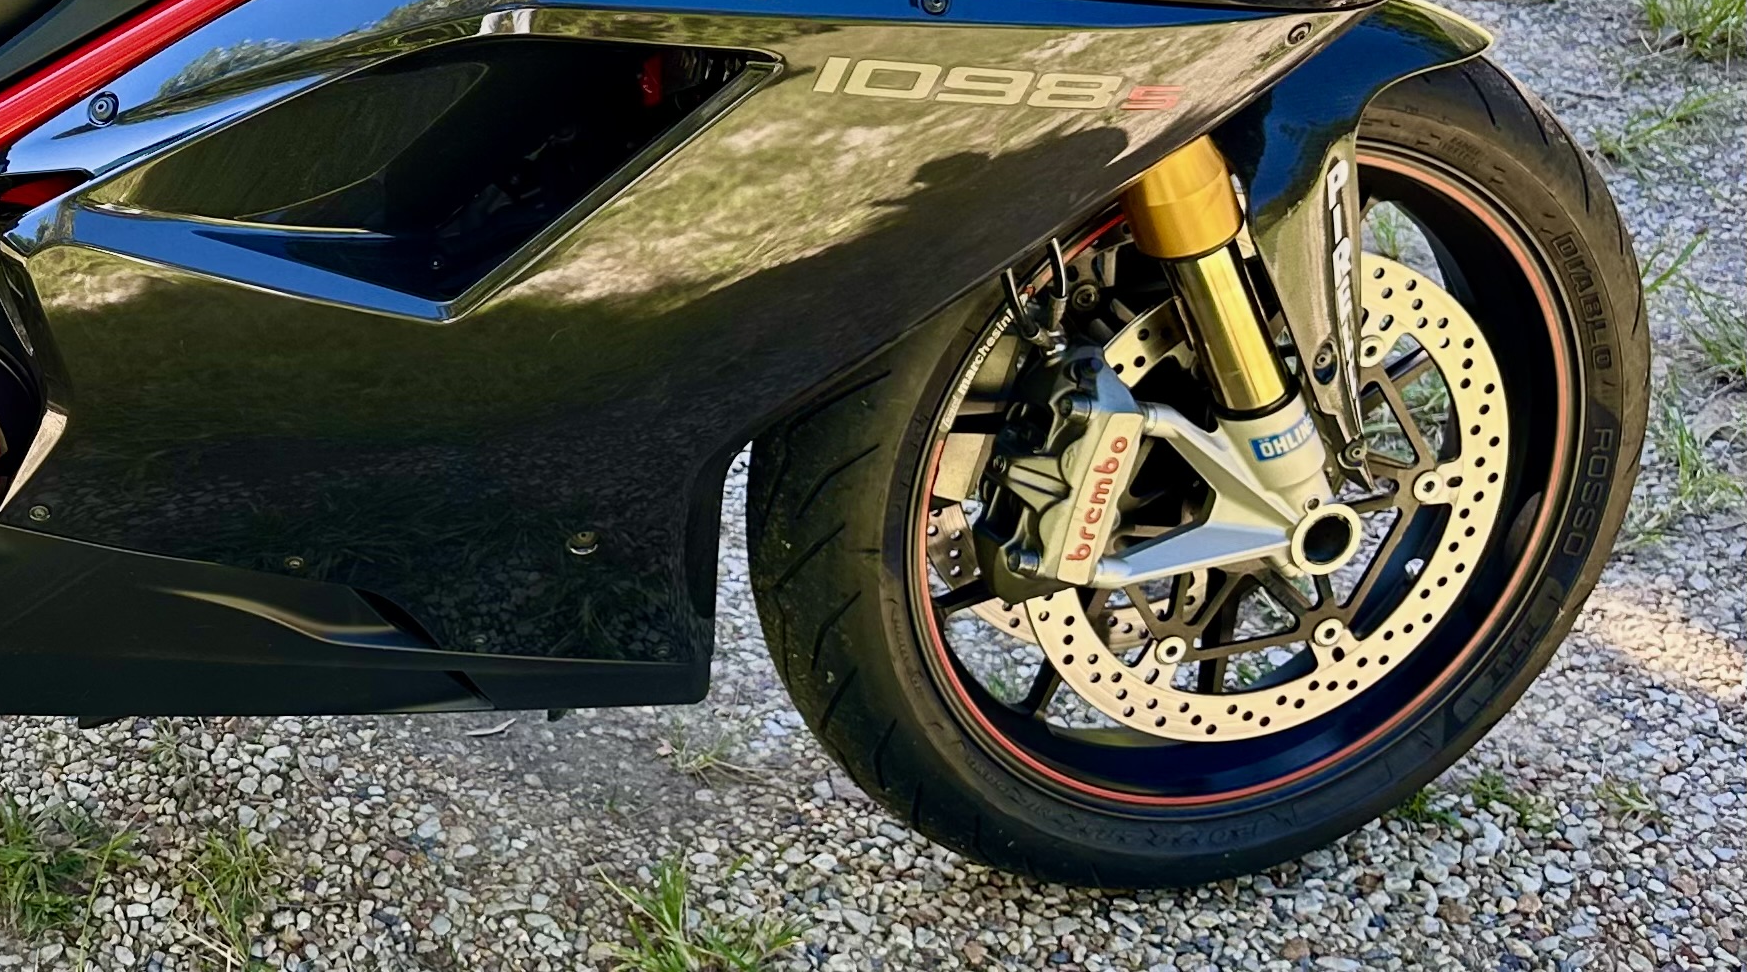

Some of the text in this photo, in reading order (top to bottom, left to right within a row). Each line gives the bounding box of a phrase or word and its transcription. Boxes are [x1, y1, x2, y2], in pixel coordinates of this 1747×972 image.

[957, 308, 1015, 395] marchesini
[1552, 231, 1612, 371] DIABLO
[1065, 436, 1128, 561] brembo
[1562, 428, 1614, 557] ROSSO
